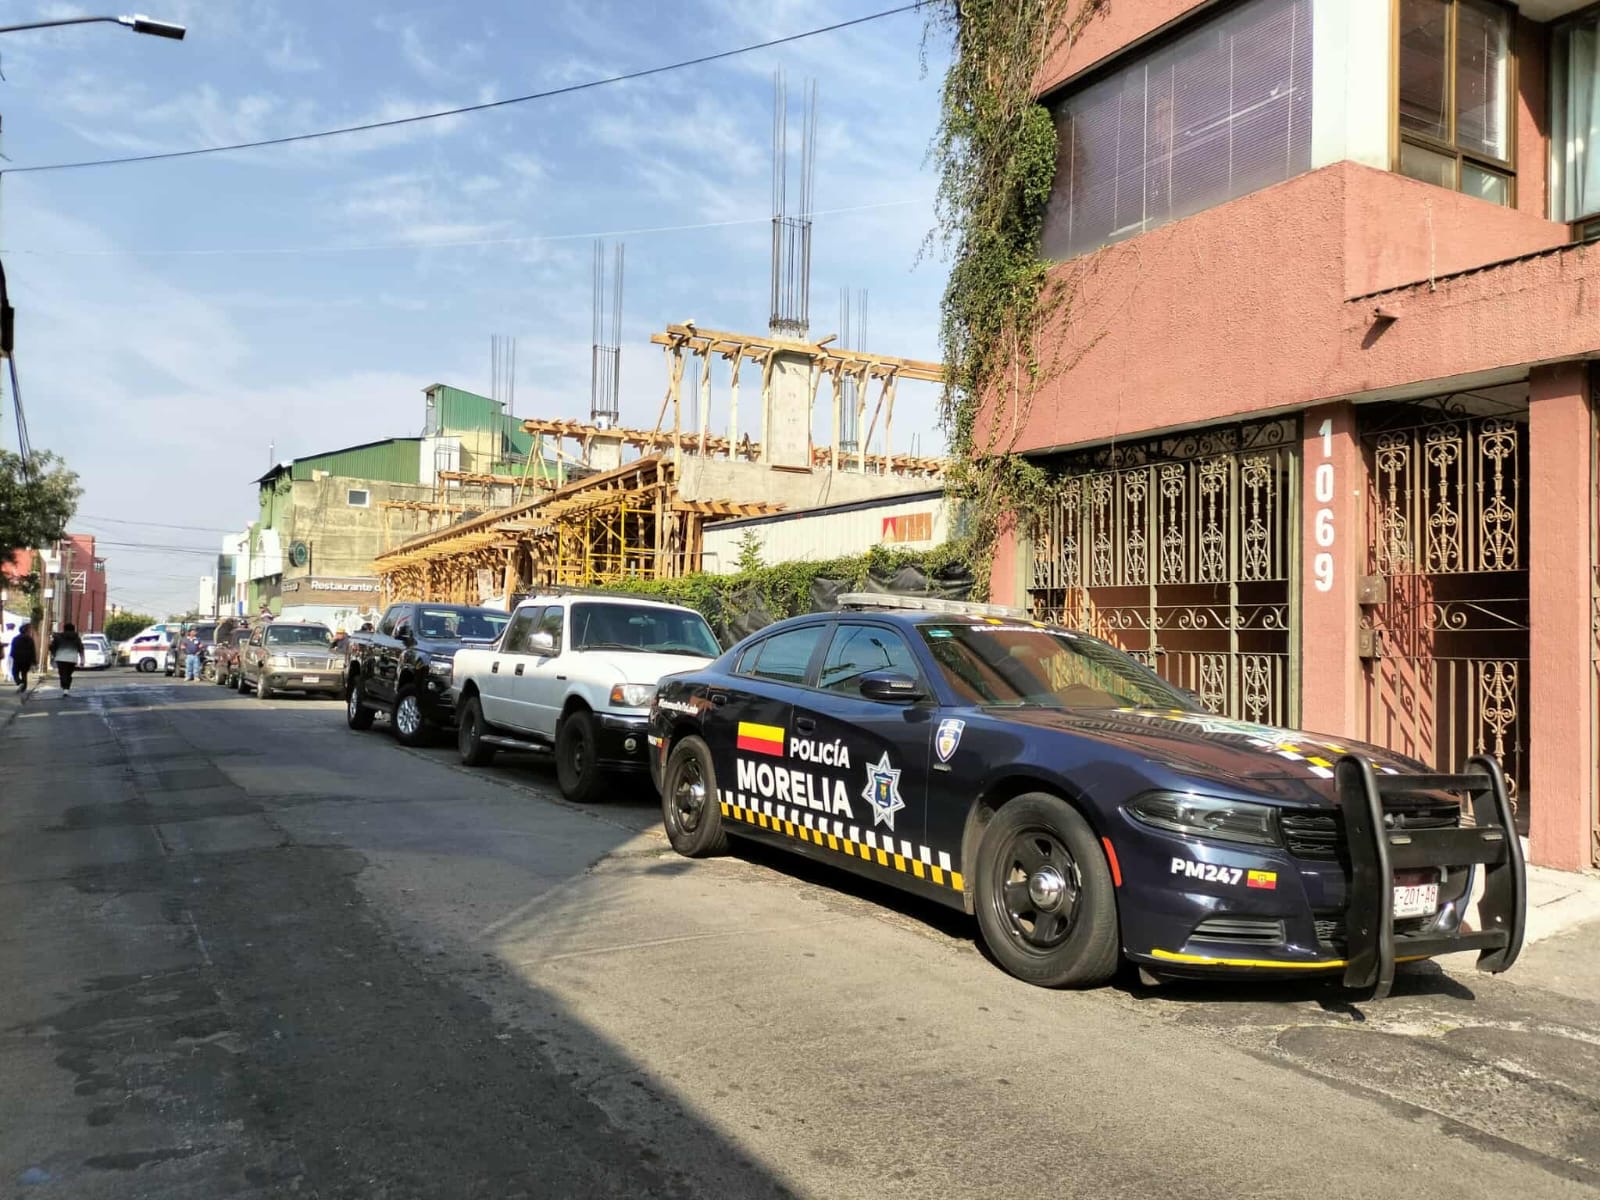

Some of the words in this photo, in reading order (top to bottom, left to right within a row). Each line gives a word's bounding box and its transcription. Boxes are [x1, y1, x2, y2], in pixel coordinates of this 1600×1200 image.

[1314, 418, 1335, 592] 1069
[311, 581, 373, 593] Restaurante
[789, 738, 851, 769] POLICÍA
[736, 758, 854, 819] MORELIA
[1170, 857, 1243, 885] PM247
